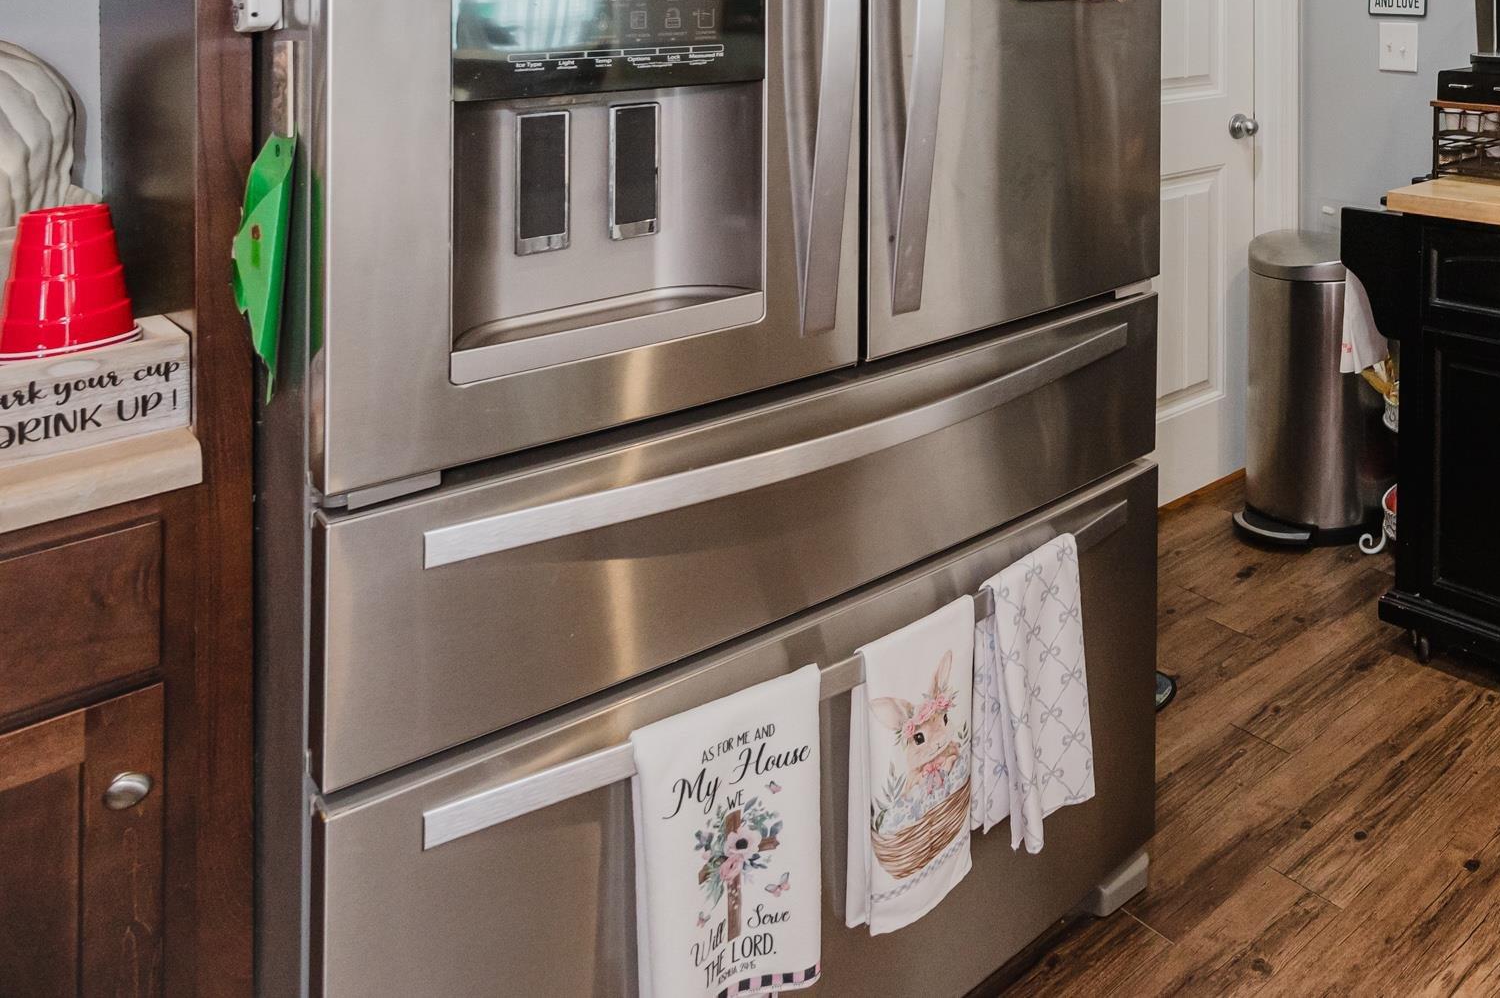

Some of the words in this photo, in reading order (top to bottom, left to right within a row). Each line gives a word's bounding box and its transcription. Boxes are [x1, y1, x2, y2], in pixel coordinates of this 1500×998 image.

[54, 371, 124, 406] your
[133, 361, 180, 382] cup
[701, 747, 714, 764] AS
[717, 737, 733, 756] FOR
[736, 730, 750, 745] ME
[754, 723, 776, 741] AND
[662, 768, 722, 820] My
[729, 742, 811, 786] House
[726, 789, 744, 810] WE
[690, 918, 726, 967] Will
[747, 903, 791, 929] Serve
[704, 948, 726, 988] THE
[731, 933, 777, 963] LORD.
